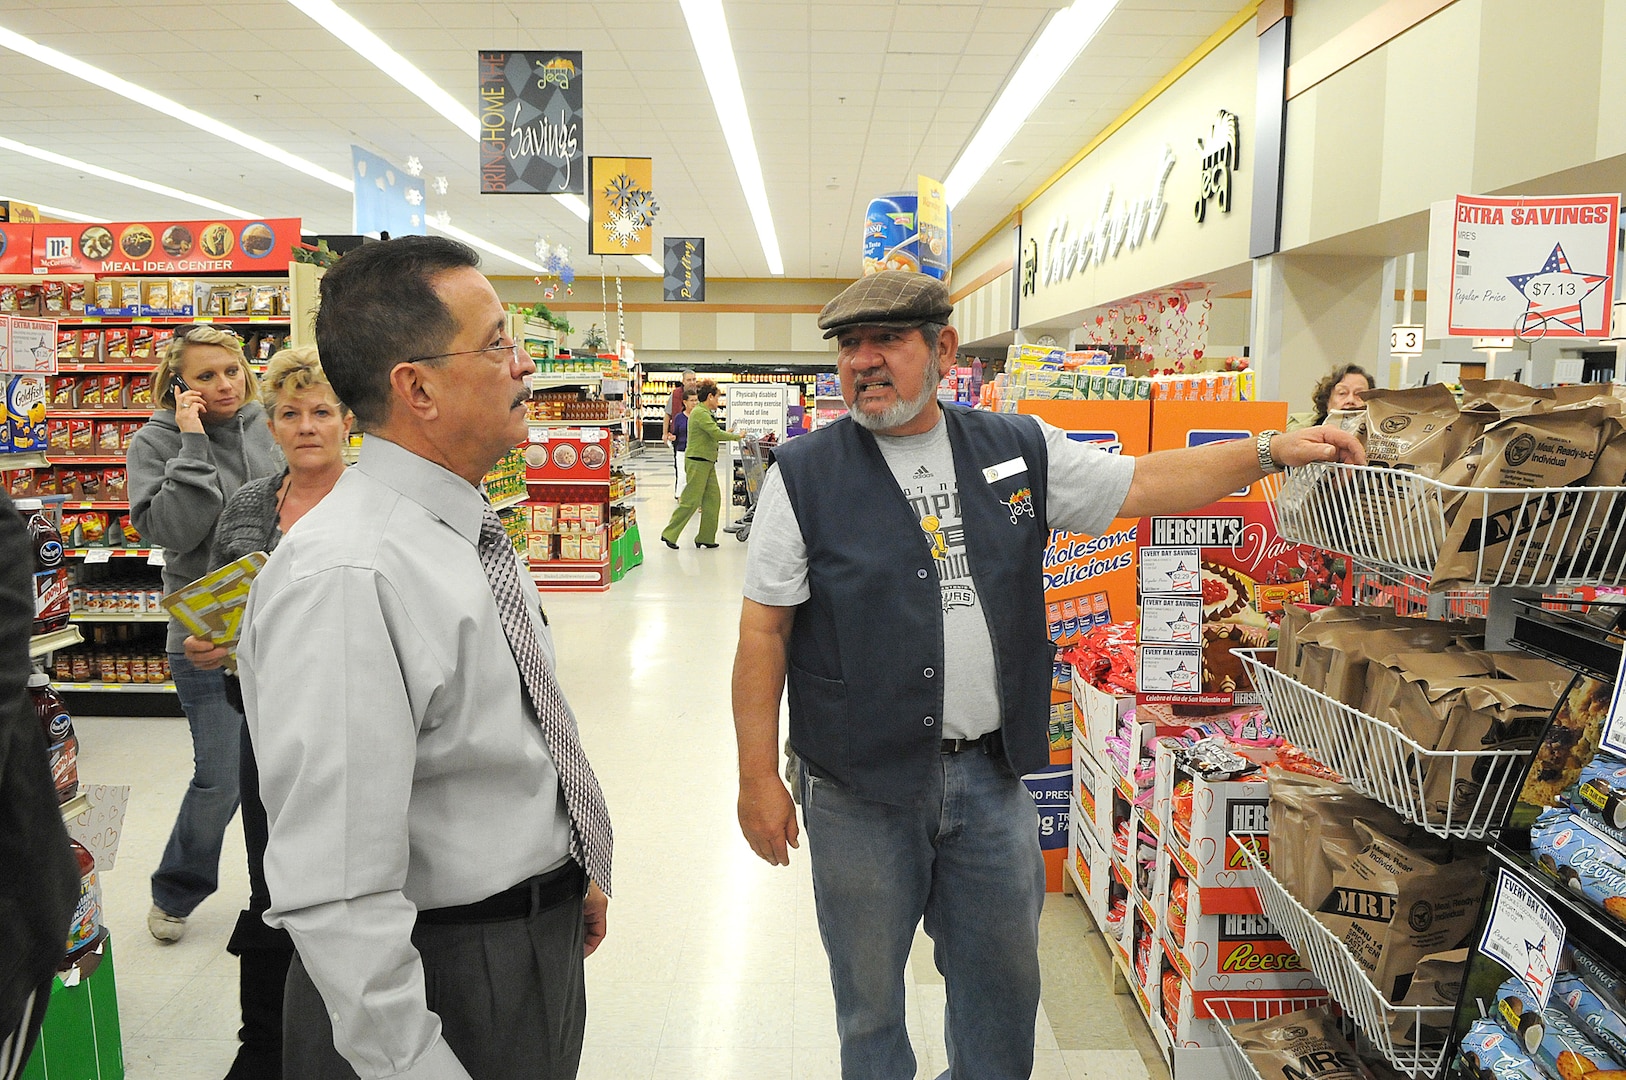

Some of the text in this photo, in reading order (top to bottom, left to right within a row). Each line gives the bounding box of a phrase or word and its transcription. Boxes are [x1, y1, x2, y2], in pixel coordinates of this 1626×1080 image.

[481, 53, 505, 85] THE
[510, 102, 577, 190] Savings
[1041, 143, 1176, 288] Checkout
[1458, 205, 1608, 226] EXTRA SAVINGS
[1457, 231, 1477, 241] MRE'S
[101, 260, 233, 272] MEAL IDEA CENTER
[680, 241, 696, 299] Poultry
[1455, 288, 1507, 305] Regular Price
[1532, 282, 1576, 297] $7.13
[14, 321, 31, 329] EXTRA
[32, 322, 53, 331] SAVINGS
[1405, 333, 1416, 348] 3
[15, 384, 44, 407] Goldfish
[759, 390, 777, 398] disabled
[1366, 453, 1399, 461] GETARIAN
[1531, 453, 1567, 467] Individual
[912, 472, 934, 480] adidas
[1494, 493, 1577, 539] MRE
[1155, 519, 1239, 545] HERSHEY'S
[1145, 694, 1166, 702] Celebra
[1029, 791, 1043, 799] NO
[1580, 808, 1623, 843] Coconut
[1372, 844, 1392, 861] Meal,
[1369, 851, 1402, 875] Individua
[1337, 890, 1398, 918] MRE
[1504, 878, 1562, 941] EVERY DAY SAVINGS
[1345, 935, 1364, 954] PASTA
[1348, 928, 1366, 945] SPICY
[1351, 921, 1383, 951] MENU 14
[1493, 929, 1523, 956] Regular Price
[1574, 950, 1619, 990] Coconut
